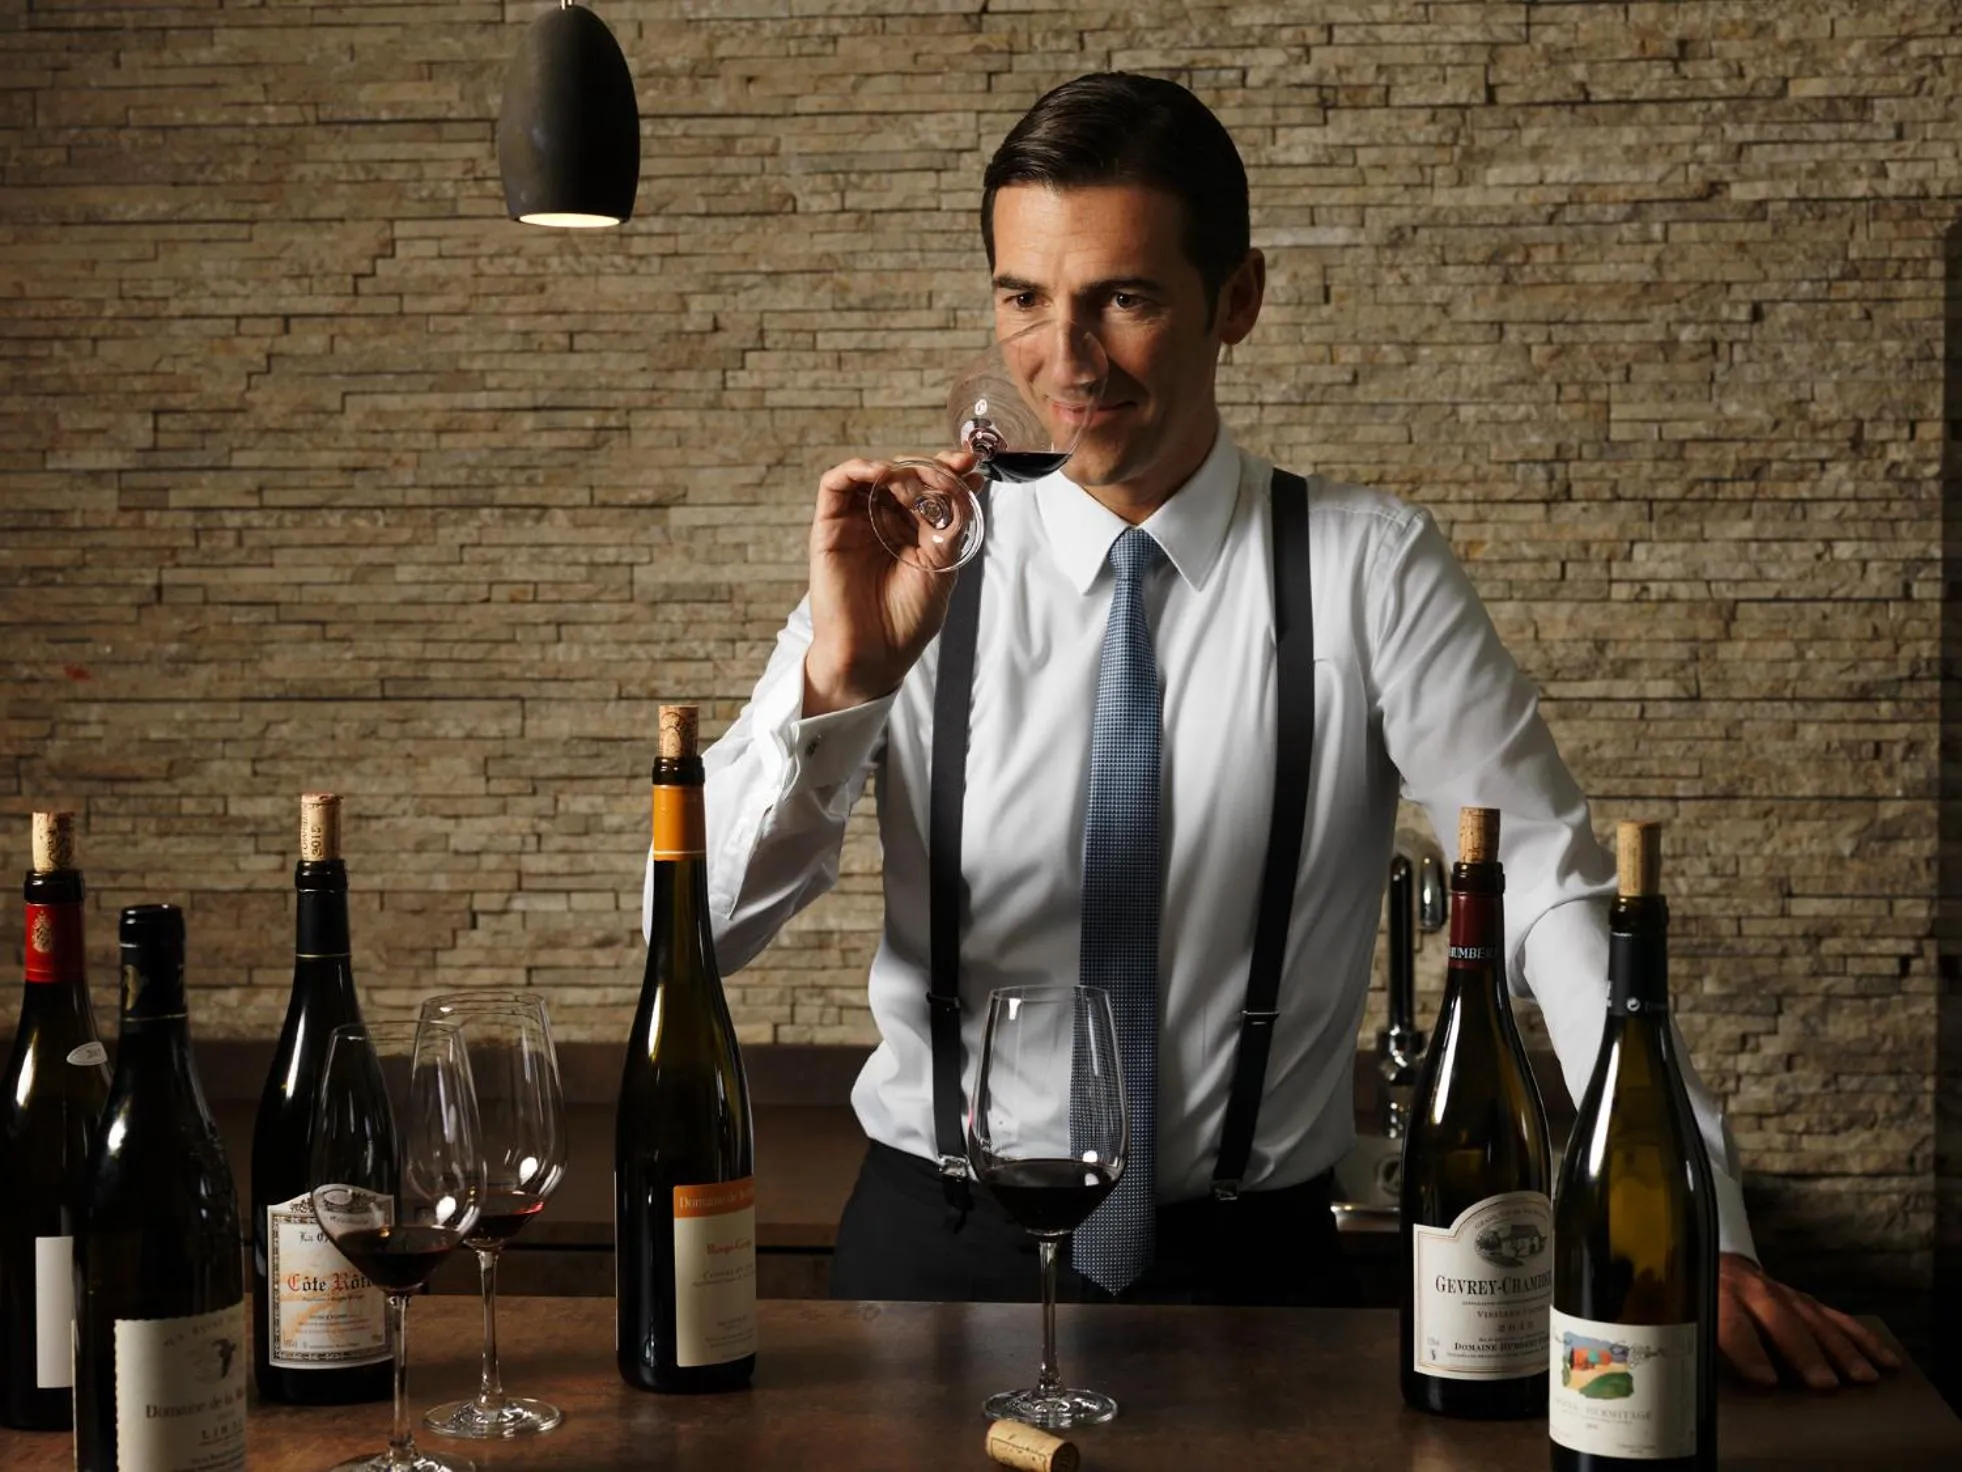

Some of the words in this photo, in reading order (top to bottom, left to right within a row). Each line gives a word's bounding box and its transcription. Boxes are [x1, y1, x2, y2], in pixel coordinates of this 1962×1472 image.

[288, 1273, 327, 1292] Côte
[333, 1272, 373, 1291] Rôti
[1454, 1341, 1498, 1353] DOMAINE
[146, 1402, 206, 1418] Domaine
